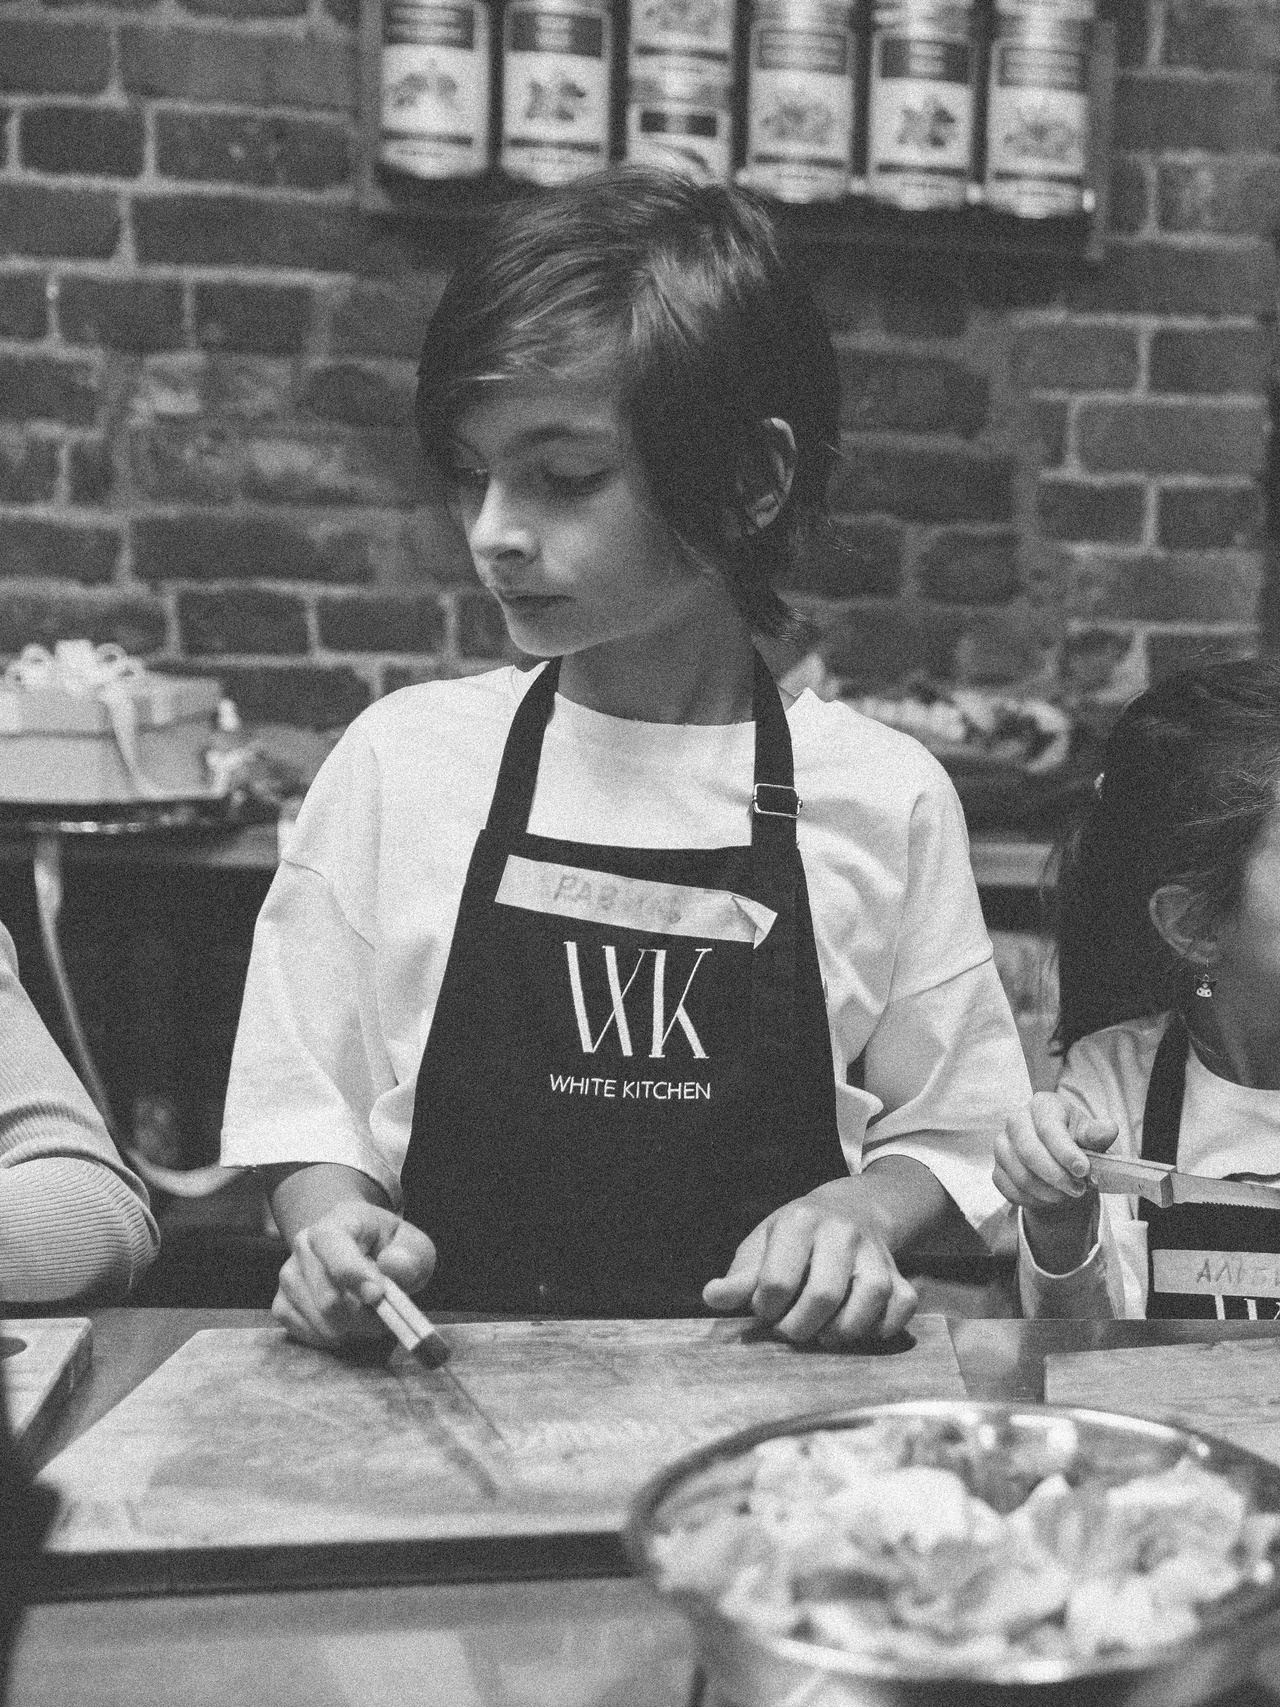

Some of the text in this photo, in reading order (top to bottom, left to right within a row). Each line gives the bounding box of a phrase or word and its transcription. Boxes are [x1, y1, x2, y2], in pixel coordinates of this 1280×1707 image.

[563, 941, 712, 1059] WK
[549, 1074, 711, 1100] WHITE KITCHEN
